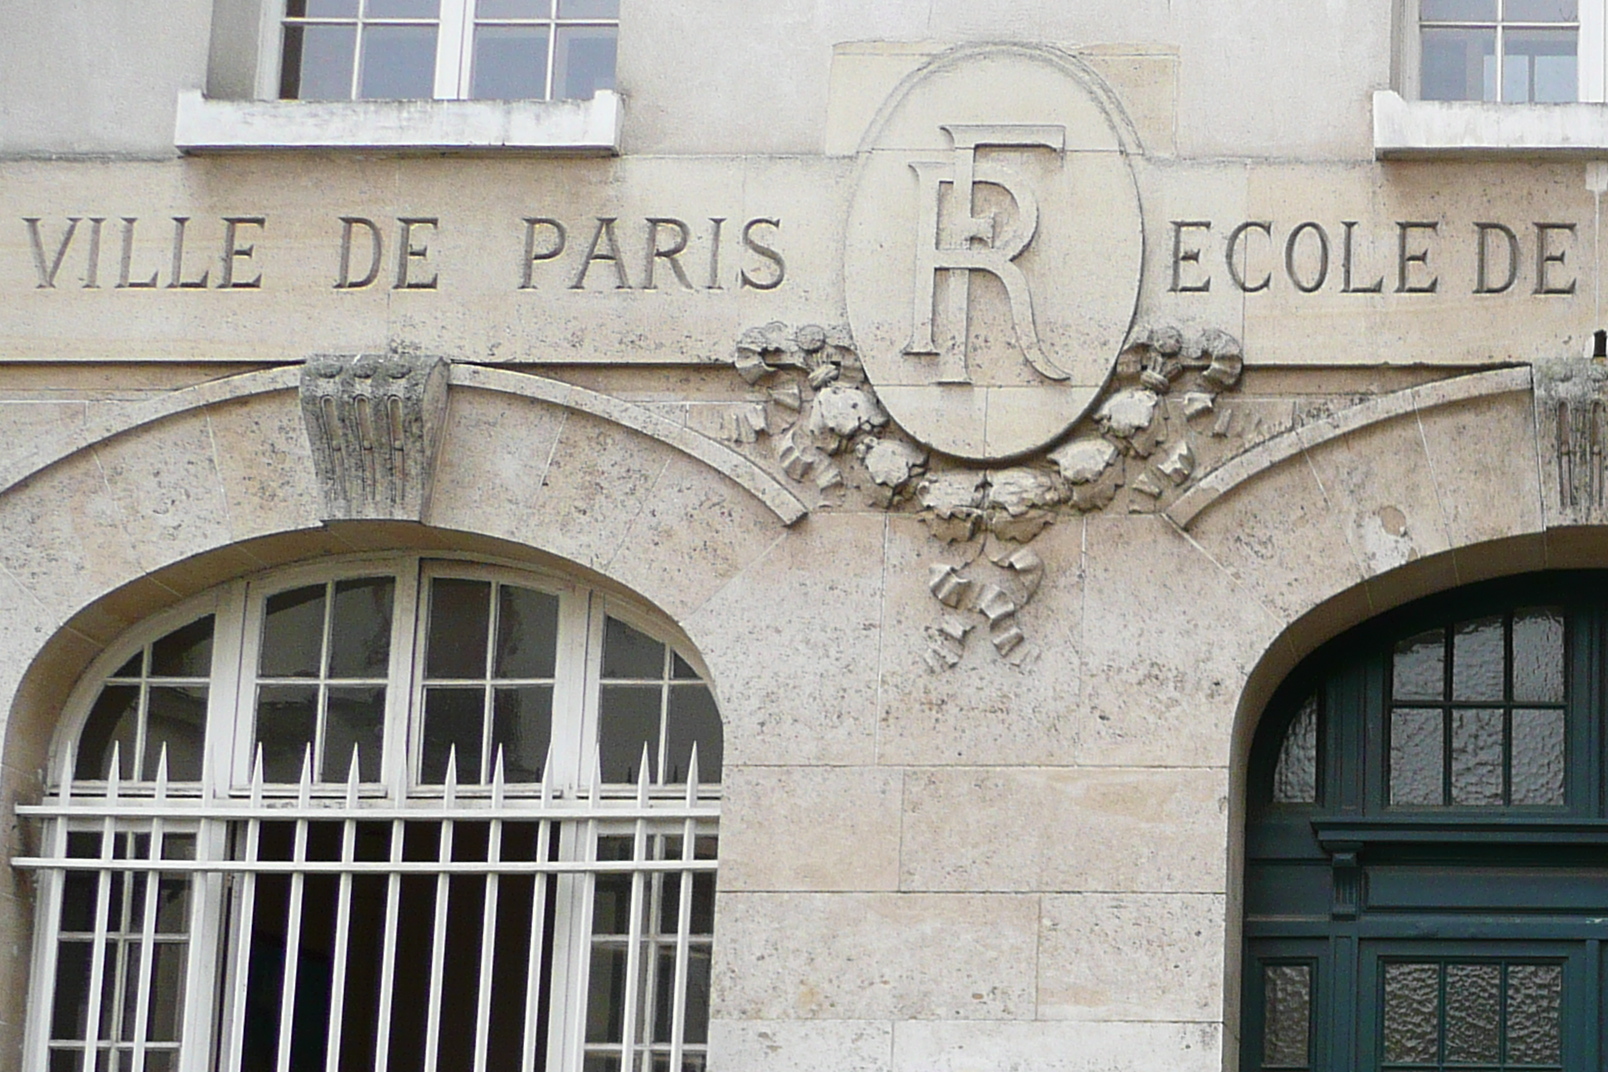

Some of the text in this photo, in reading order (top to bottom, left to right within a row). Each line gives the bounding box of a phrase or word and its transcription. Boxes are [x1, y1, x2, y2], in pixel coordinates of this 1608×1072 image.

[23, 216, 787, 290] VILLE DE PARIS
[1166, 220, 1440, 295] ECOLE
[1471, 221, 1578, 296] DE
